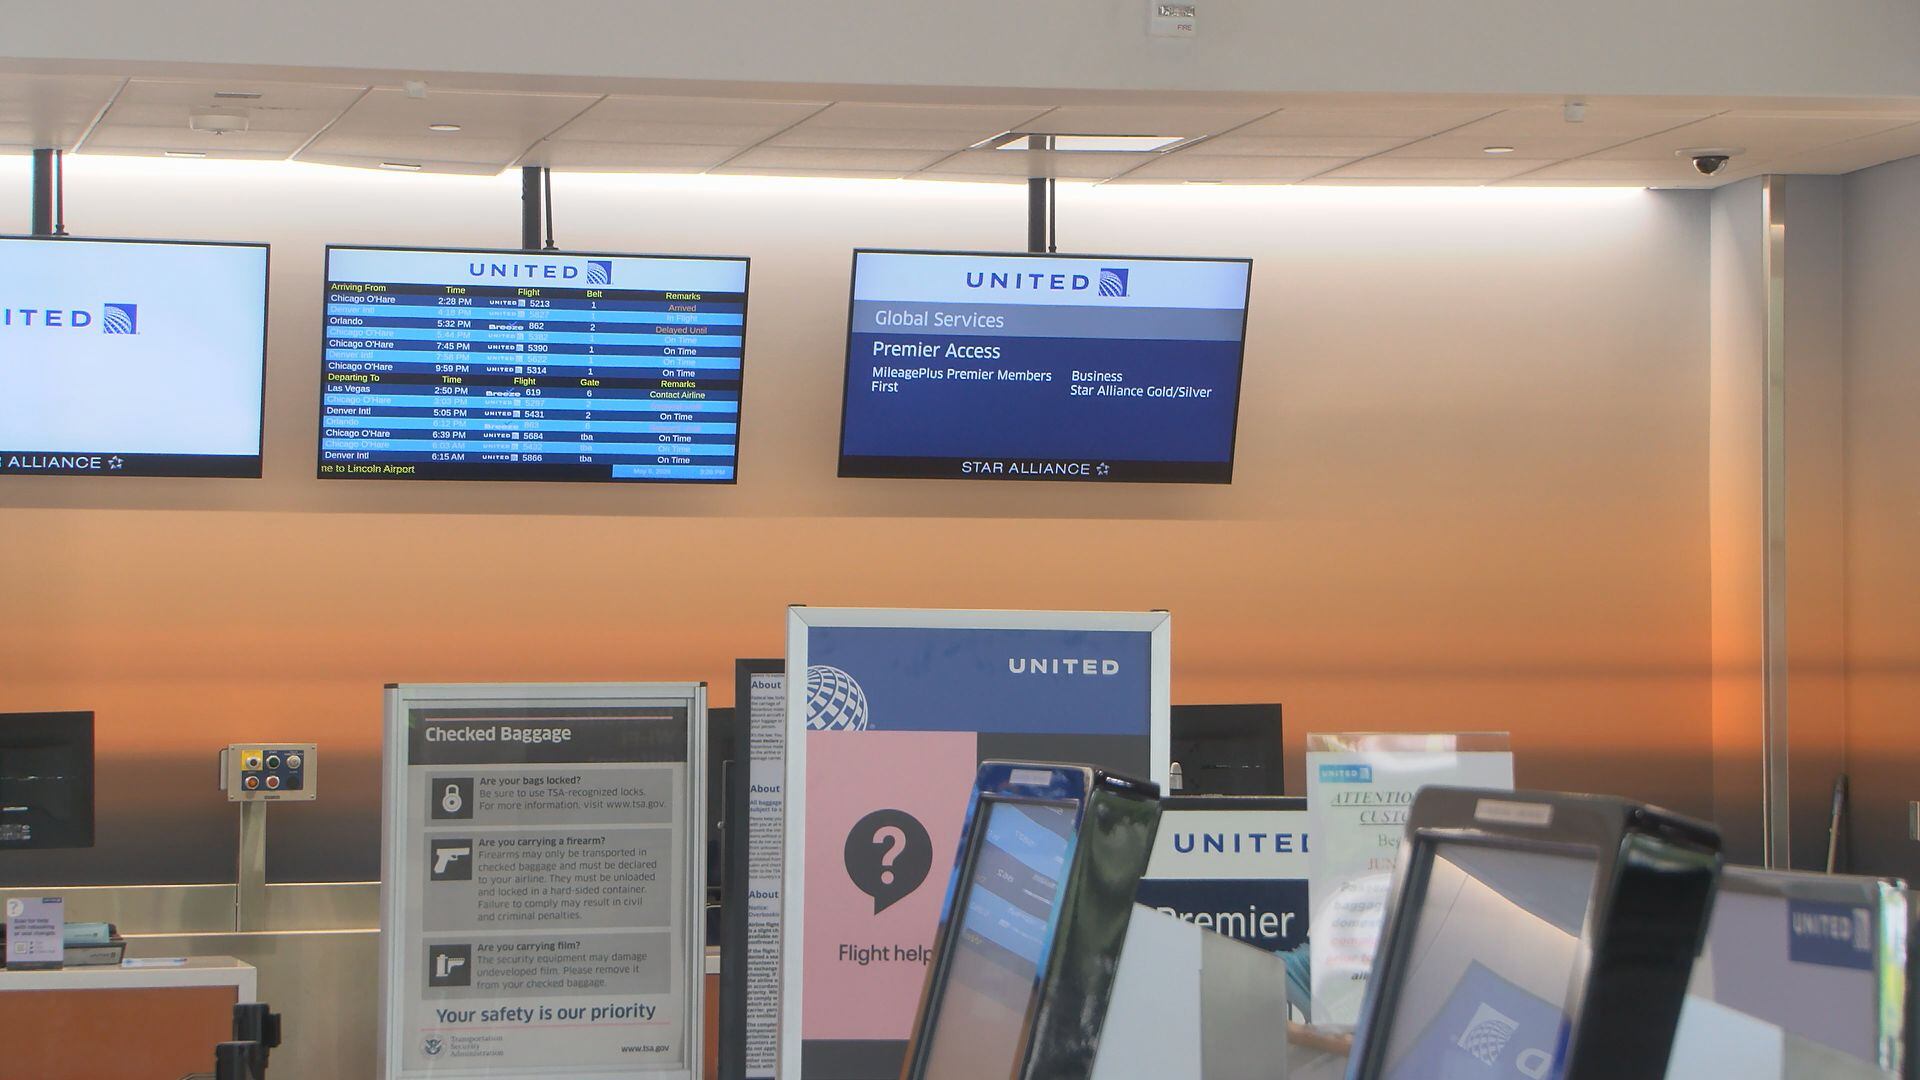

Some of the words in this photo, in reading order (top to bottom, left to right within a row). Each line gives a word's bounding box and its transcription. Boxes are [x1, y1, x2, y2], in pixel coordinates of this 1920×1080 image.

[469, 263, 578, 279] UNITED
[966, 272, 1090, 290] UNITED
[331, 283, 363, 293] Arriving
[364, 284, 386, 292] From
[446, 286, 466, 295] Time
[518, 288, 540, 297] Flight
[586, 290, 602, 298] Belt
[666, 292, 701, 300] Remarks
[331, 295, 364, 303] Chicago
[438, 297, 456, 305] 2:28
[458, 298, 472, 306] PM
[530, 300, 550, 308] 5213
[668, 304, 697, 312] Arrived
[5, 308, 92, 327] ITED
[875, 310, 928, 326] Global
[933, 312, 1004, 328] Services
[330, 317, 363, 326] Orlando
[437, 320, 455, 328] 5:32
[457, 320, 471, 328] PM
[528, 322, 544, 330] 862
[655, 326, 687, 334] Delayed
[689, 326, 707, 334] Until
[329, 340, 363, 349] Chicago
[365, 340, 394, 349] O'Hare
[437, 342, 455, 350] 7:45
[457, 343, 470, 351] PM
[527, 344, 548, 352] 5390
[663, 347, 675, 355] On
[677, 348, 697, 356] Time
[873, 341, 940, 357] Premier
[944, 343, 1001, 359] Access
[328, 362, 362, 371] Chicago
[364, 363, 393, 371] O'Hare
[435, 365, 453, 373] 9:59
[456, 365, 469, 373] PM
[526, 366, 547, 374] 5314
[662, 369, 674, 377] On
[872, 366, 944, 380] MileagePlus
[946, 368, 994, 380] Premier
[997, 369, 1052, 382] Members
[1071, 370, 1123, 382] Business
[328, 374, 367, 383] Departing
[370, 374, 379, 382] To
[442, 376, 462, 384] Time
[513, 377, 536, 385] Flight
[580, 378, 600, 387] Gate
[661, 380, 696, 388] Remarks
[871, 380, 899, 393] First
[327, 385, 341, 393] Las
[344, 385, 371, 394] Vegas
[434, 387, 452, 395] 2:50
[454, 387, 468, 395] PM
[650, 391, 679, 399] Contact
[681, 391, 706, 399] Airline
[1070, 384, 1094, 396] Star
[1096, 385, 1143, 397] Alliance
[1146, 386, 1212, 398] Gold/Silver
[326, 407, 356, 415] Denver
[433, 409, 451, 417] 5:05
[453, 409, 467, 417] PM
[525, 410, 544, 418] 5431
[325, 429, 360, 438] Chicago
[361, 430, 390, 438] O'Hare
[453, 431, 466, 439] PM
[523, 432, 543, 440] 5684
[580, 433, 593, 441] tba
[8, 455, 101, 469] ALLIANCE
[325, 451, 354, 459] Denver
[450, 453, 465, 461] AM
[522, 454, 542, 462] 5866
[657, 456, 669, 464] On
[671, 456, 690, 464] Time
[336, 465, 345, 473] to
[347, 464, 382, 473] Lincoln
[383, 465, 415, 475] Airport
[961, 461, 1003, 474] STAR
[1008, 462, 1090, 475] ALLIANCE
[1008, 658, 1119, 675] UNITED
[751, 680, 782, 689] About
[425, 726, 496, 742] Checked
[500, 726, 572, 744] Baggage
[1321, 769, 1358, 777] UNITED
[480, 777, 496, 785] Are
[499, 777, 521, 788] your
[523, 776, 544, 788] bags
[546, 775, 581, 785] locked?
[750, 784, 780, 793] About
[479, 789, 492, 798] Be
[494, 790, 514, 798] sure
[517, 789, 527, 797] to
[529, 789, 545, 797] use
[547, 787, 617, 799] TSA-recognized
[1331, 791, 1413, 805] ATTENTIO
[479, 801, 495, 810] For
[497, 802, 522, 810] more
[584, 800, 603, 808] visit
[479, 838, 496, 846] Are
[498, 839, 515, 848] you
[517, 837, 556, 847] carrying
[566, 836, 606, 845] firearm?
[479, 850, 520, 859] Firearms
[522, 850, 542, 859] may
[545, 849, 565, 859] only
[568, 849, 579, 857] be
[582, 848, 636, 858] transported
[638, 848, 647, 856] in
[749, 890, 779, 899] About
[1792, 911, 1851, 940] UNITED
[477, 943, 494, 951] Are
[496, 943, 514, 953] you
[516, 942, 556, 952] carrying
[557, 941, 581, 950] film?
[839, 944, 889, 966] Flight
[894, 944, 933, 966] help
[436, 1008, 476, 1023] Your
[481, 1006, 534, 1024] safety
[539, 1005, 552, 1020] is
[557, 1007, 587, 1020] our
[591, 1002, 656, 1021] priority
[621, 1044, 670, 1054] www.tsa.gov
